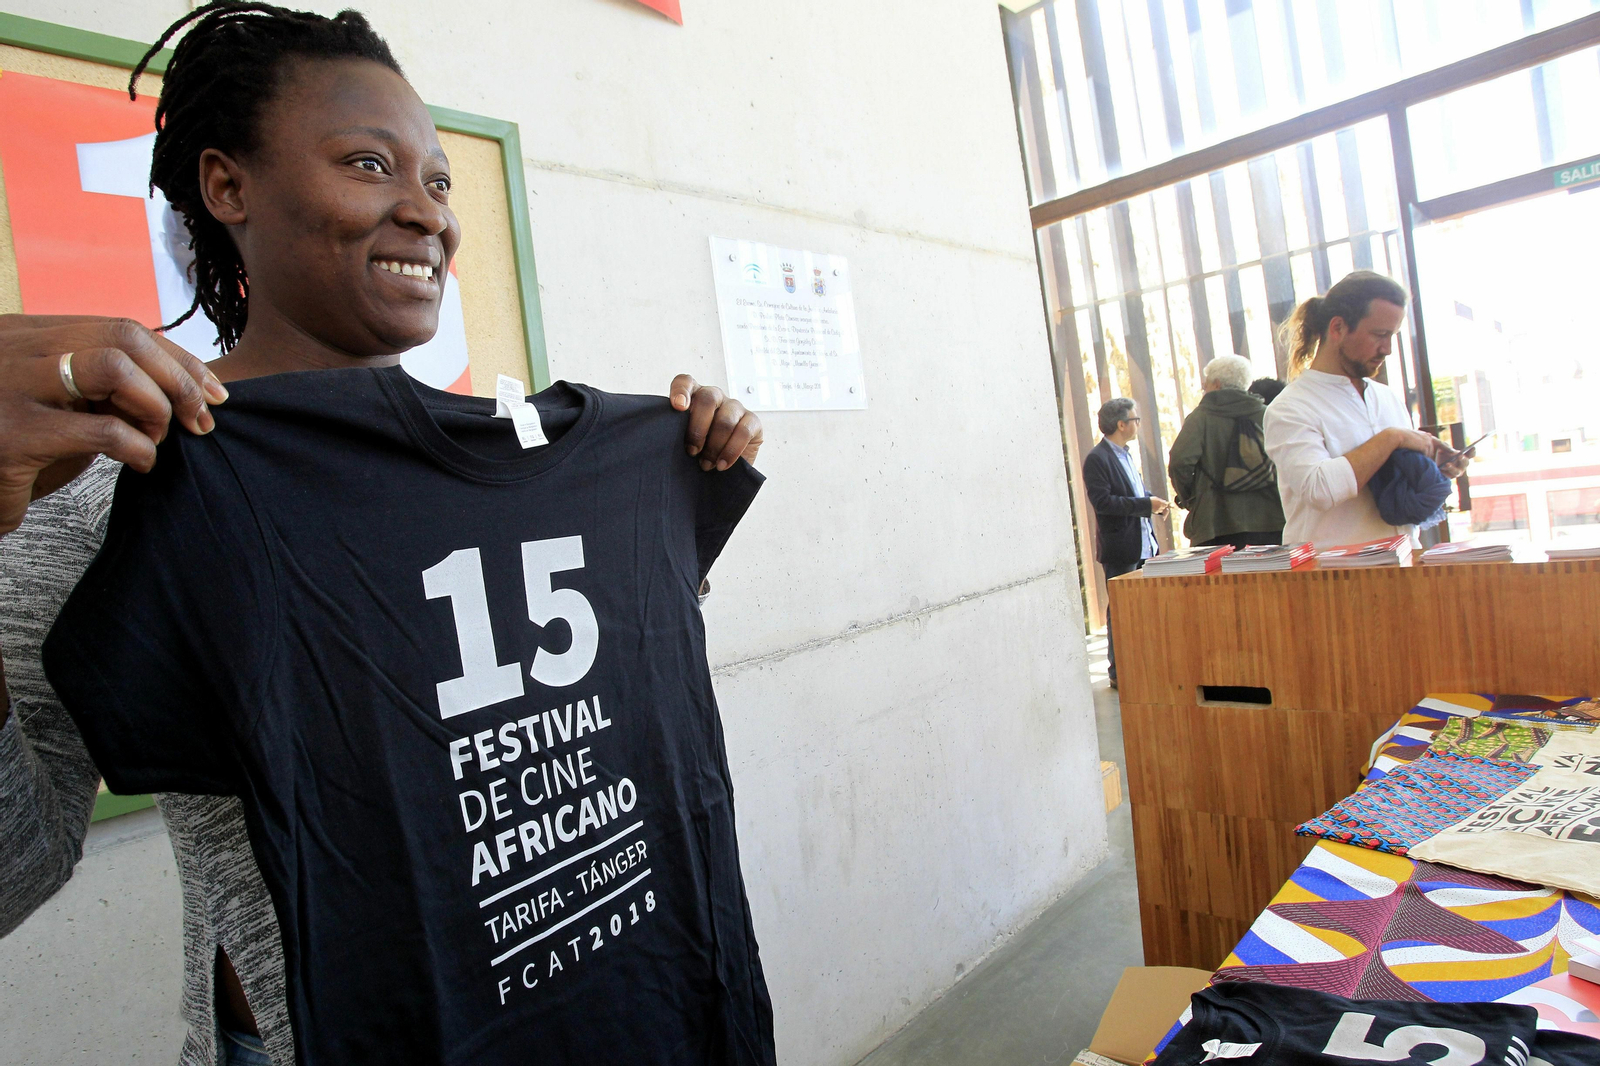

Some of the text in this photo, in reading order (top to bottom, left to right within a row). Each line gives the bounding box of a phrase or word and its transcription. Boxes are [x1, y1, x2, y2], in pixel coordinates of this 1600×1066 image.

[422, 535, 599, 720] 15
[450, 695, 612, 781] FESTIVAL
[459, 747, 597, 833] DE CINE
[472, 777, 638, 887] AFRICANO
[575, 840, 648, 895] TÁNGER
